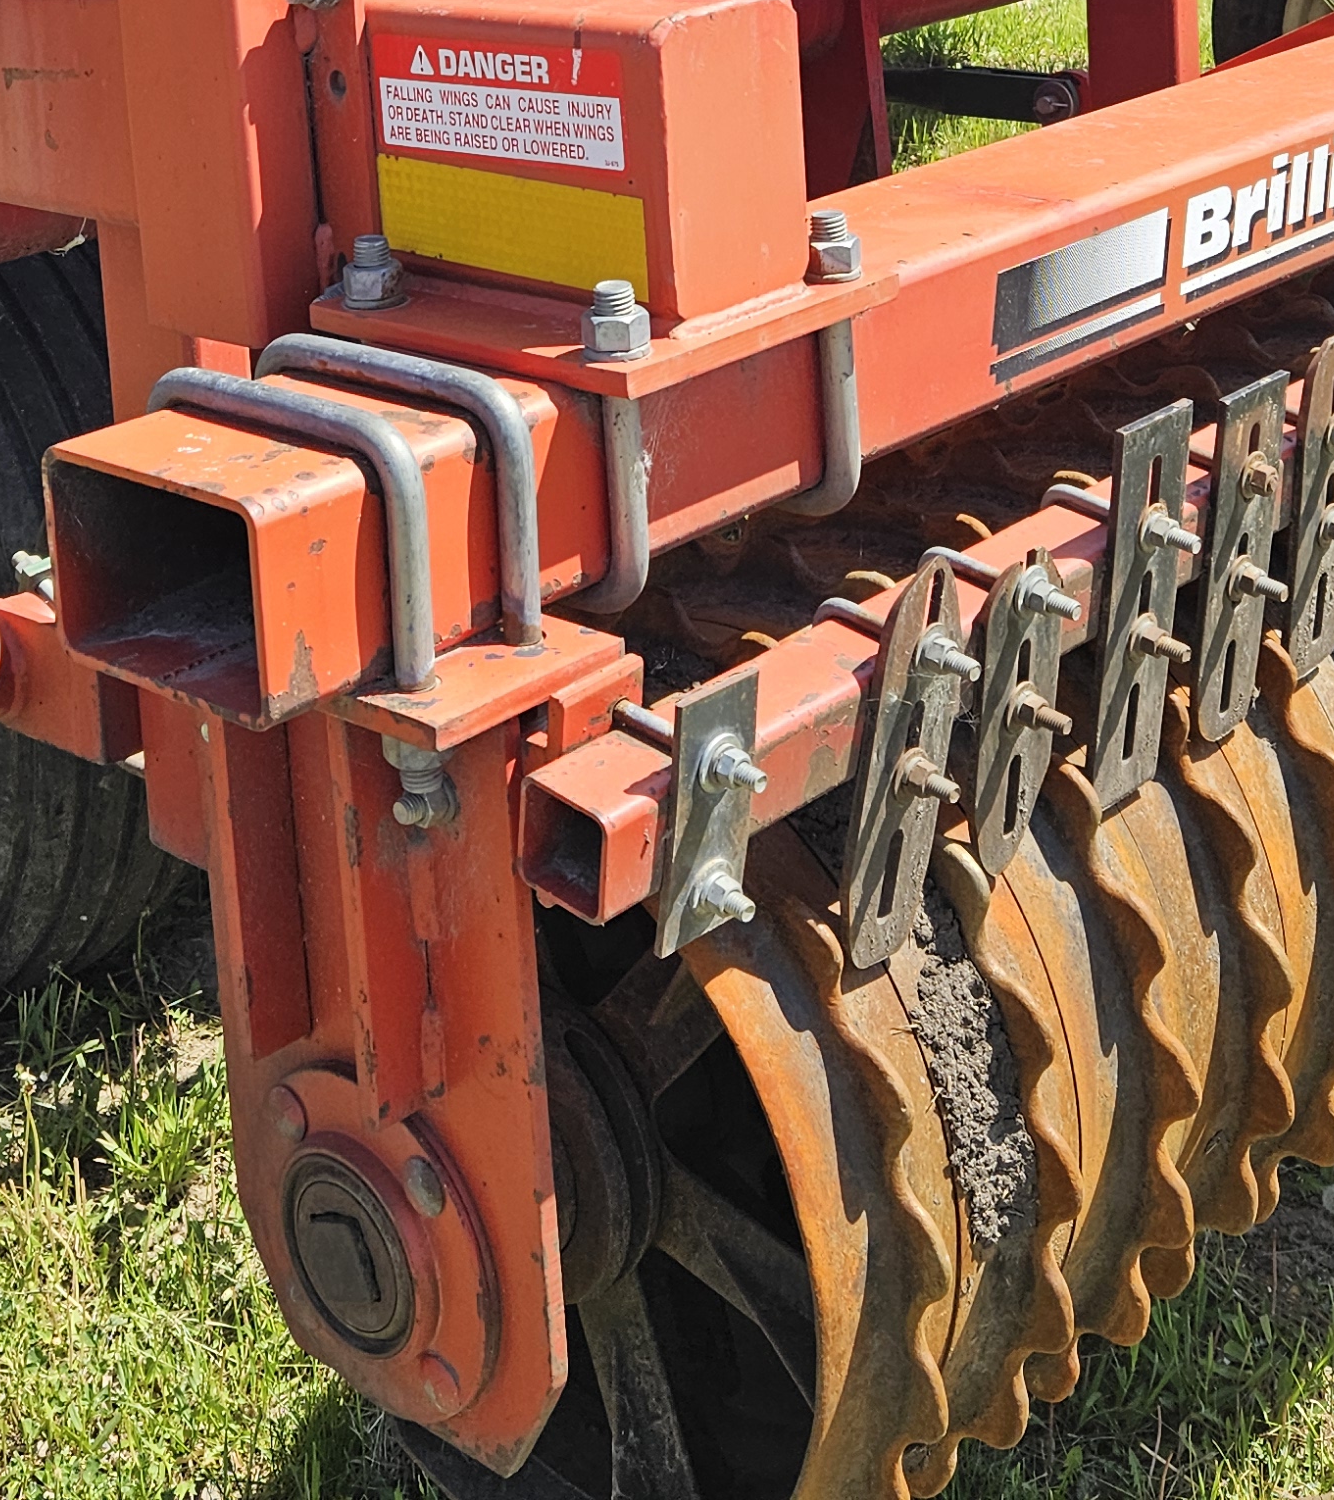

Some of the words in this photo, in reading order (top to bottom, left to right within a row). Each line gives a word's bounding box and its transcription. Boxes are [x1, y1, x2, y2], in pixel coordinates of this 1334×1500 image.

[438, 48, 549, 84] DANGER
[386, 84, 433, 104] FALLING
[439, 89, 478, 108] WINGS
[485, 93, 511, 111] CAN
[518, 97, 560, 116] CAUSE
[567, 101, 612, 120] INJURY
[388, 104, 405, 121] OR
[406, 106, 447, 126] DEATH.
[448, 111, 488, 130] STAND
[490, 115, 531, 134] CLEAR
[533, 118, 570, 138] WHEN
[572, 123, 614, 143] WINGS
[389, 125, 412, 141] ARE
[415, 127, 450, 146] BEING
[454, 132, 497, 150] RAISED
[502, 136, 519, 153] OR
[523, 139, 589, 161] LOWERED.
